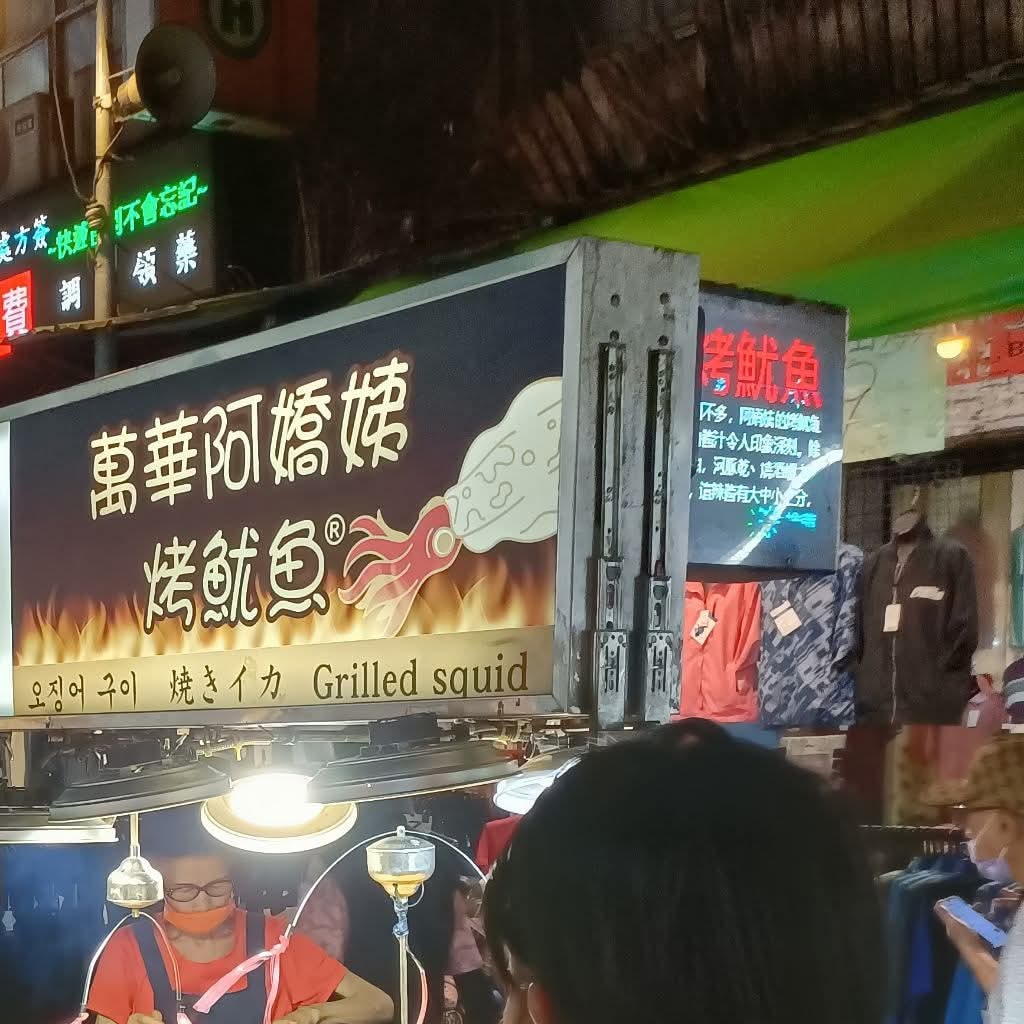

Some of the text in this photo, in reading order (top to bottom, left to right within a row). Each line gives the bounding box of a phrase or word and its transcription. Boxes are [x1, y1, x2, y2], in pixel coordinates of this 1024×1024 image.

[143, 518, 327, 630] 烤魷魚
[28, 671, 137, 713] 오징어 구이
[169, 663, 283, 705] 焼きイカ
[312, 651, 529, 700] Grilled squid
